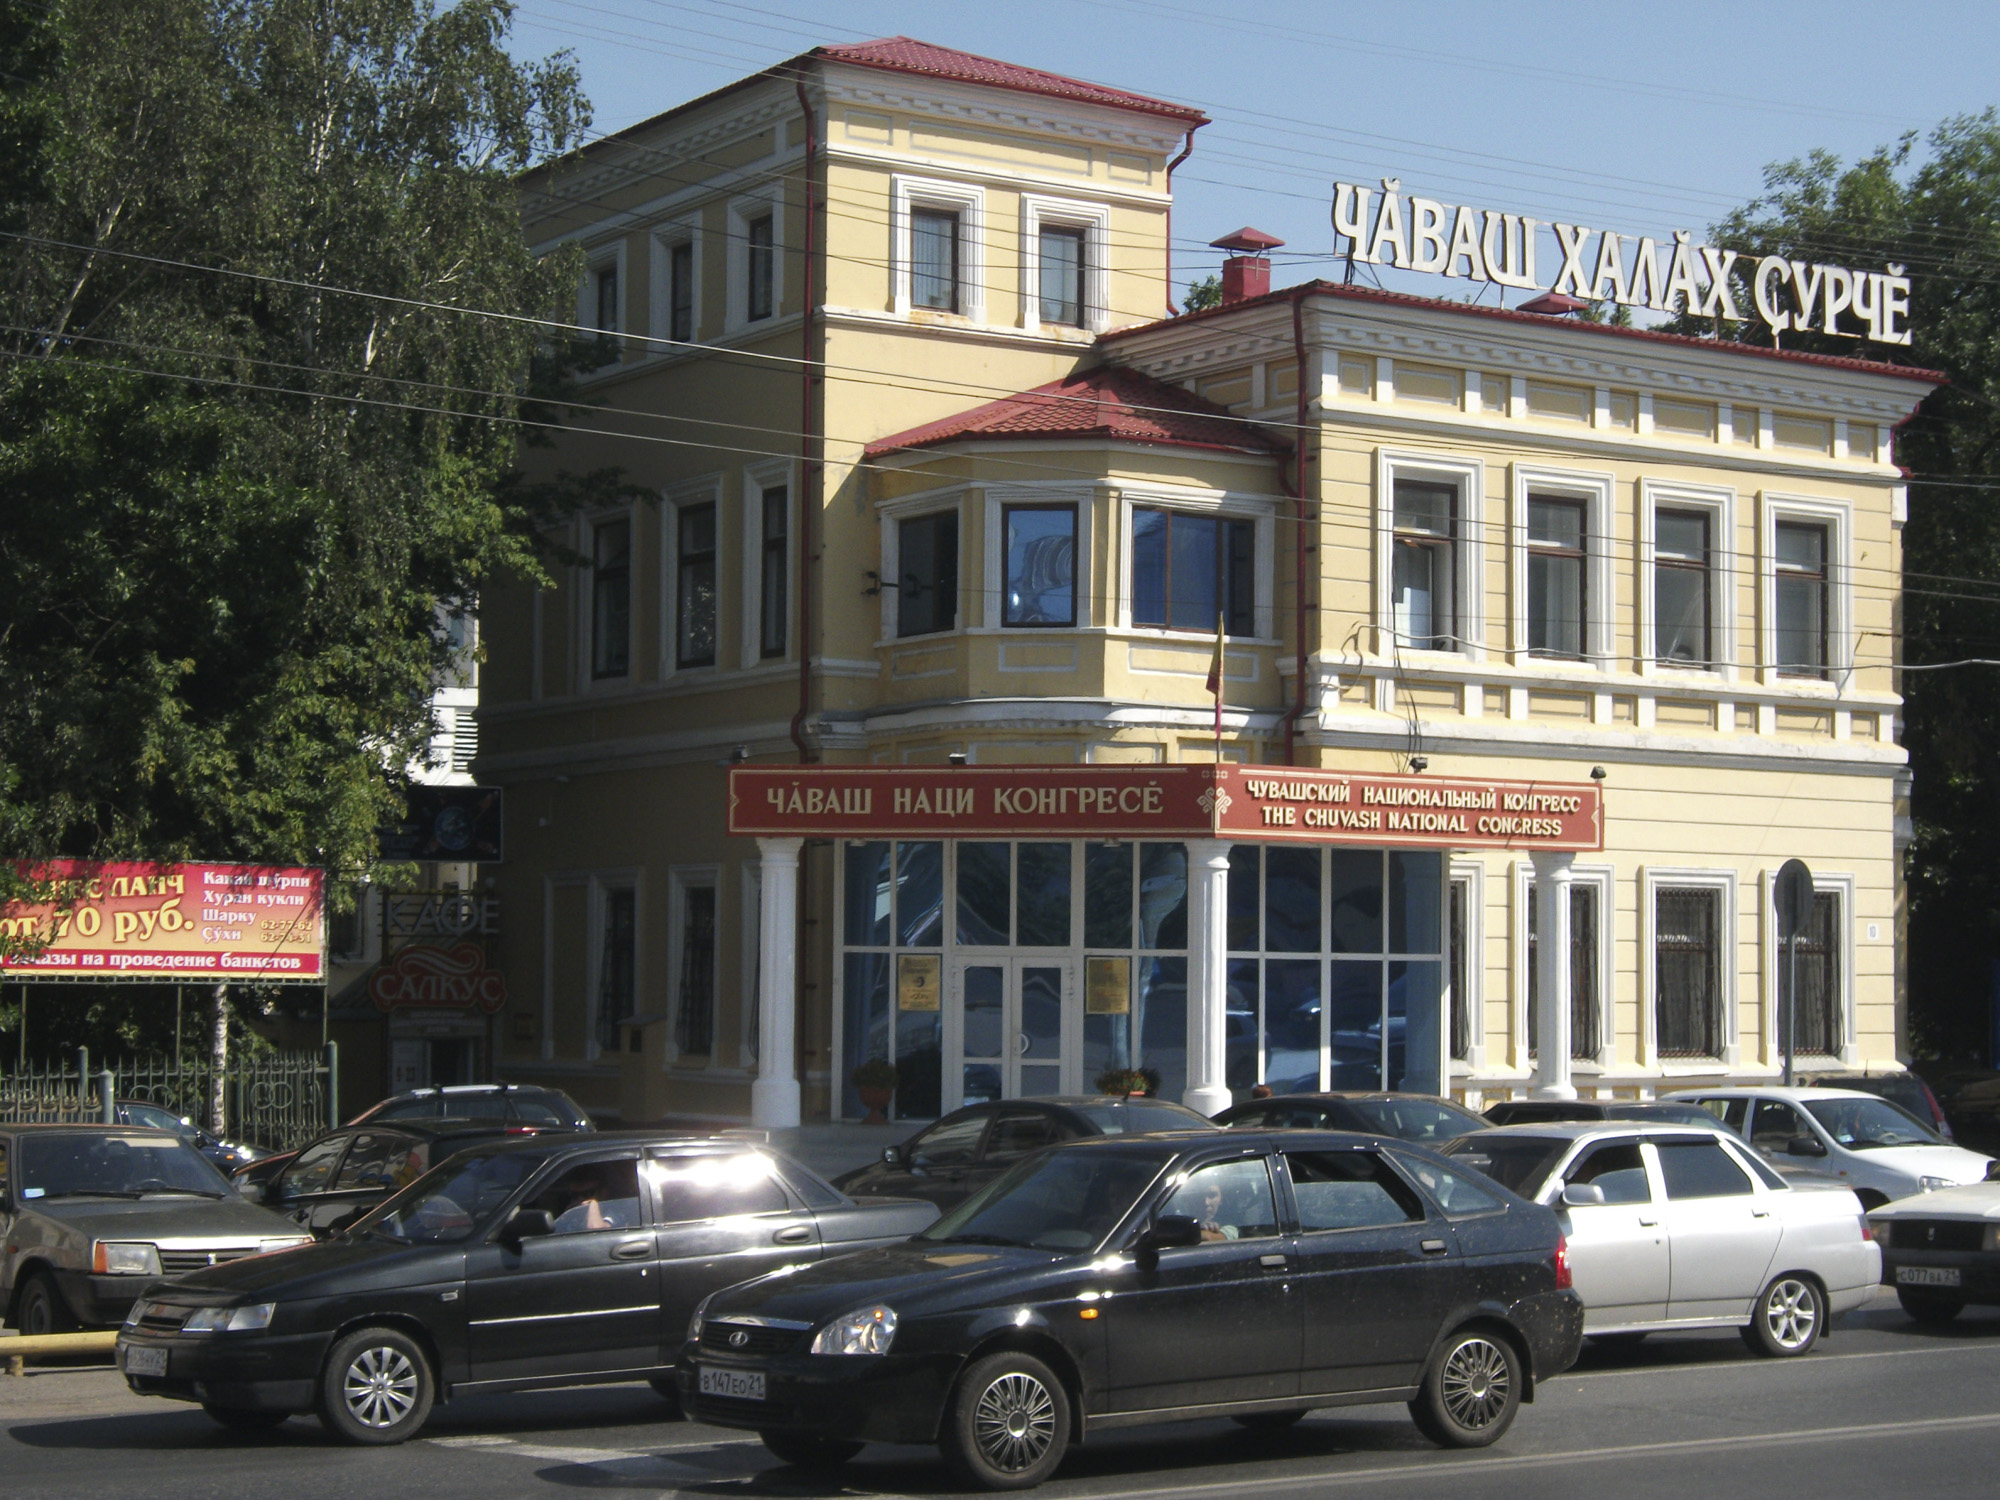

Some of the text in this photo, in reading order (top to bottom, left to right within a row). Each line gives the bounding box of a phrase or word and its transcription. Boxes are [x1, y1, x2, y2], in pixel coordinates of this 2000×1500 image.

[1333, 177, 1911, 347] ЧӐВАШ ХАЛӐХ ҪУРЧӖ
[767, 780, 1163, 817] ЧӐВАШ НАЦИ КОНГРЕСӖ
[1248, 780, 1581, 812] ЧУВАШСКИЙ НАЦИОНАЛЬНЫЙ КОНГРЕСС
[1262, 806, 1562, 836] THE CHUVASH NATIONAL CONGRESS
[111, 875, 184, 897] ЛАНЧ
[203, 890, 304, 907] Хуран кукли
[53, 906, 101, 937] 70
[113, 898, 194, 942] руб.
[203, 909, 257, 925] Шарку
[261, 920, 312, 931] 62-77-62
[386, 896, 500, 937] КАФЕ
[82, 954, 104, 966] на
[110, 954, 216, 969] проведение
[220, 952, 301, 969] банкетов
[376, 974, 501, 1002] САЛКУС
